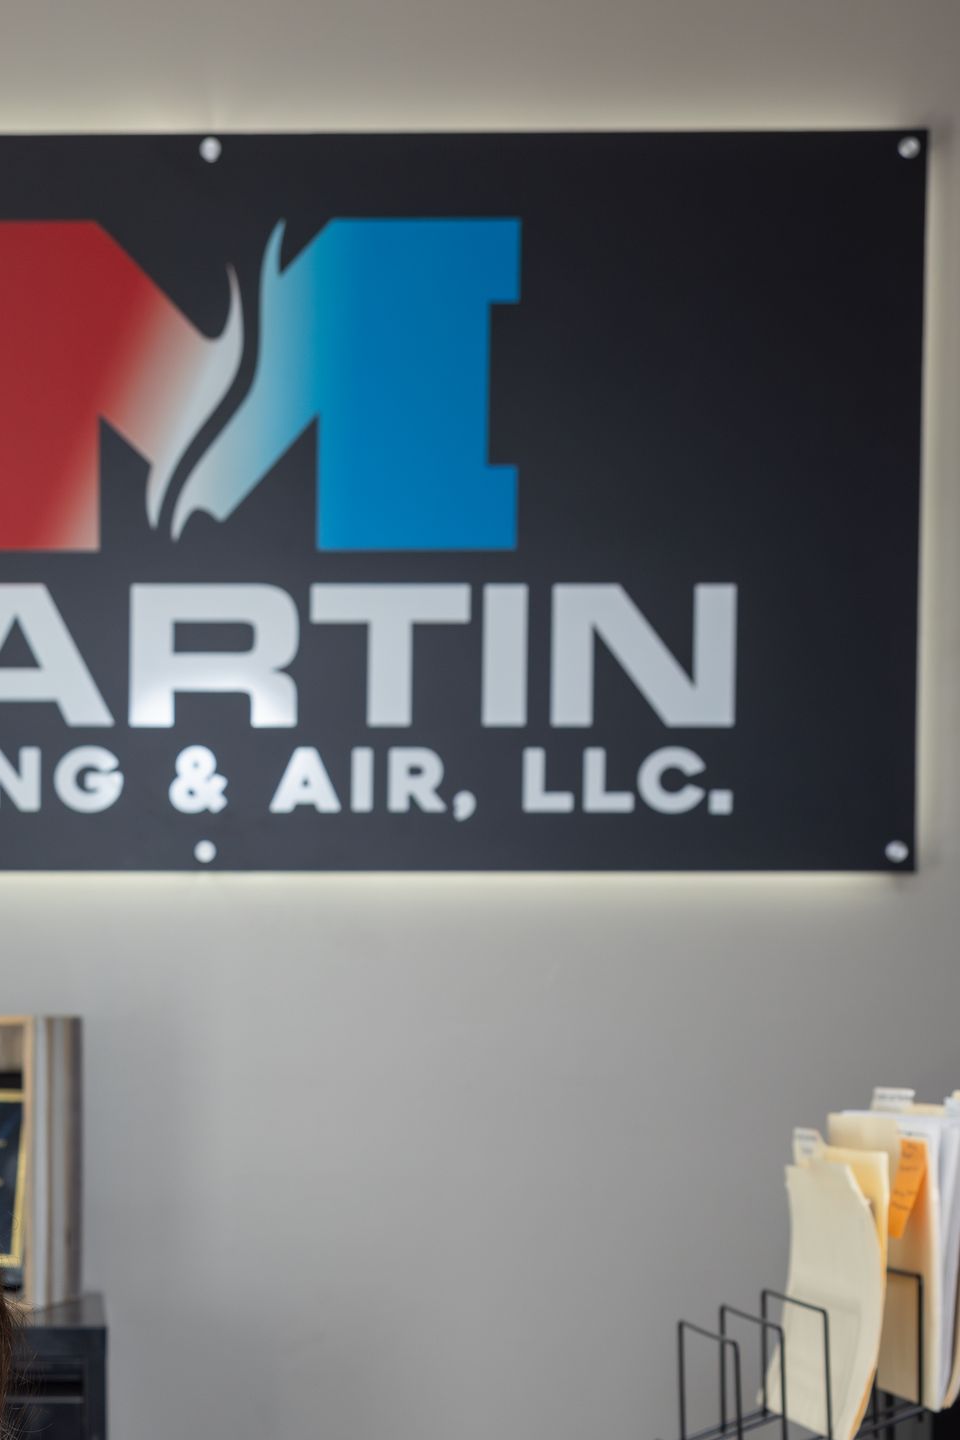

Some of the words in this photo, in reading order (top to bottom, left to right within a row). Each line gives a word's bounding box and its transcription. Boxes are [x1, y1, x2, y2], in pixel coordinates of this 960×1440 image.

[167, 747, 228, 814] &
[270, 747, 477, 822] AIR,
[522, 747, 735, 816] LLC.
